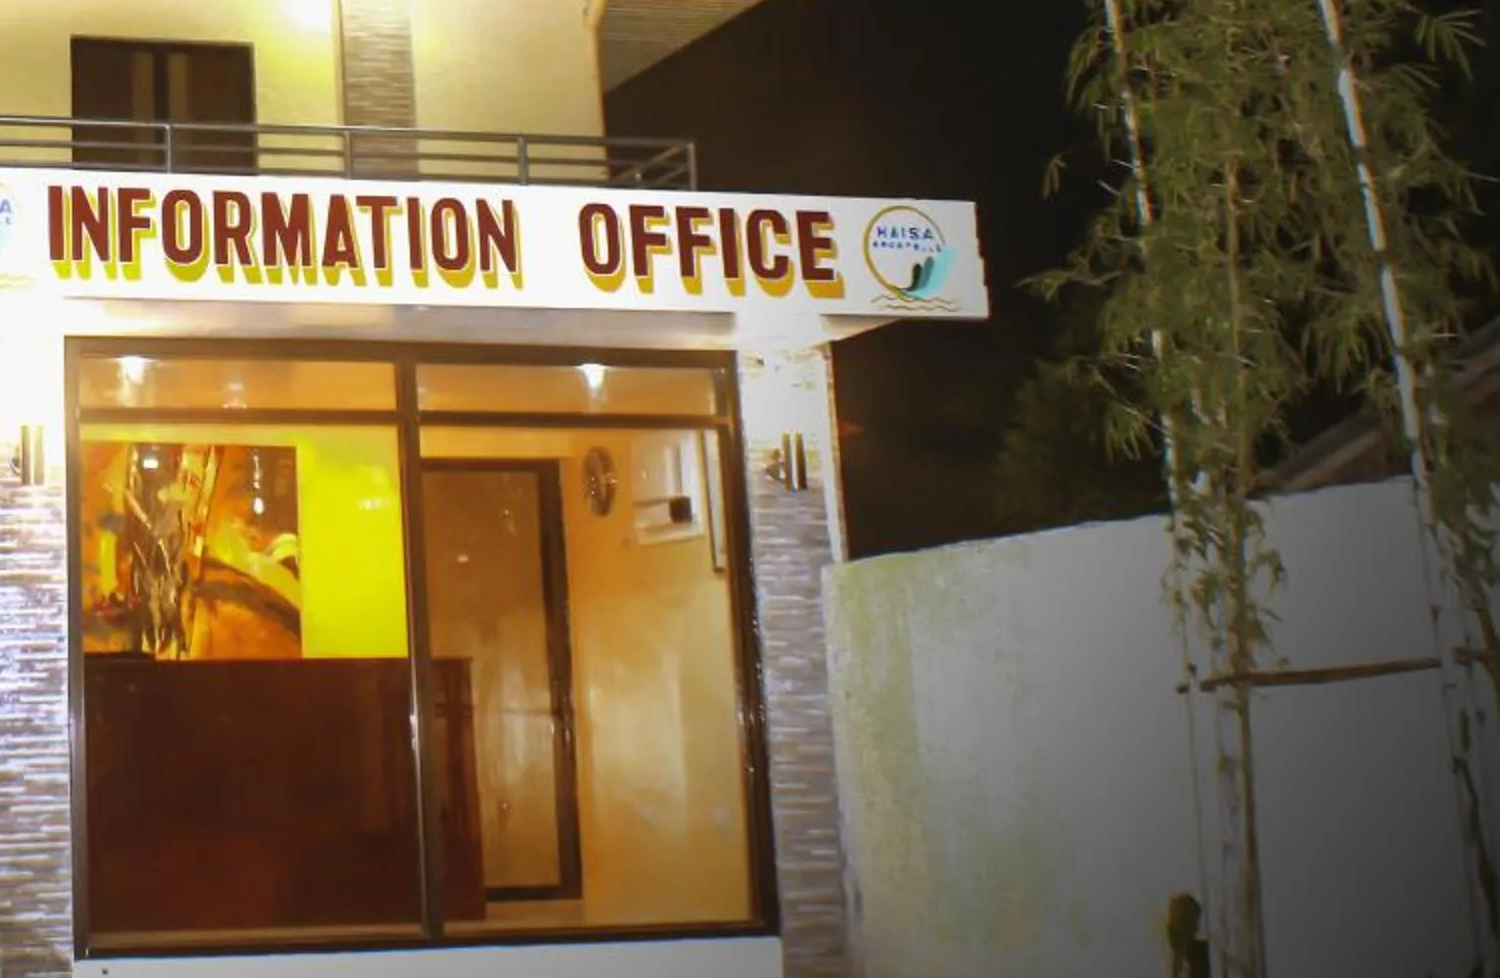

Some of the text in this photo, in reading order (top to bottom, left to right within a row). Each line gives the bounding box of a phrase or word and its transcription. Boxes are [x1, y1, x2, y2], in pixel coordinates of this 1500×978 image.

[48, 185, 836, 281] INFORMATION OFFICE
[876, 226, 933, 240] HAISA
